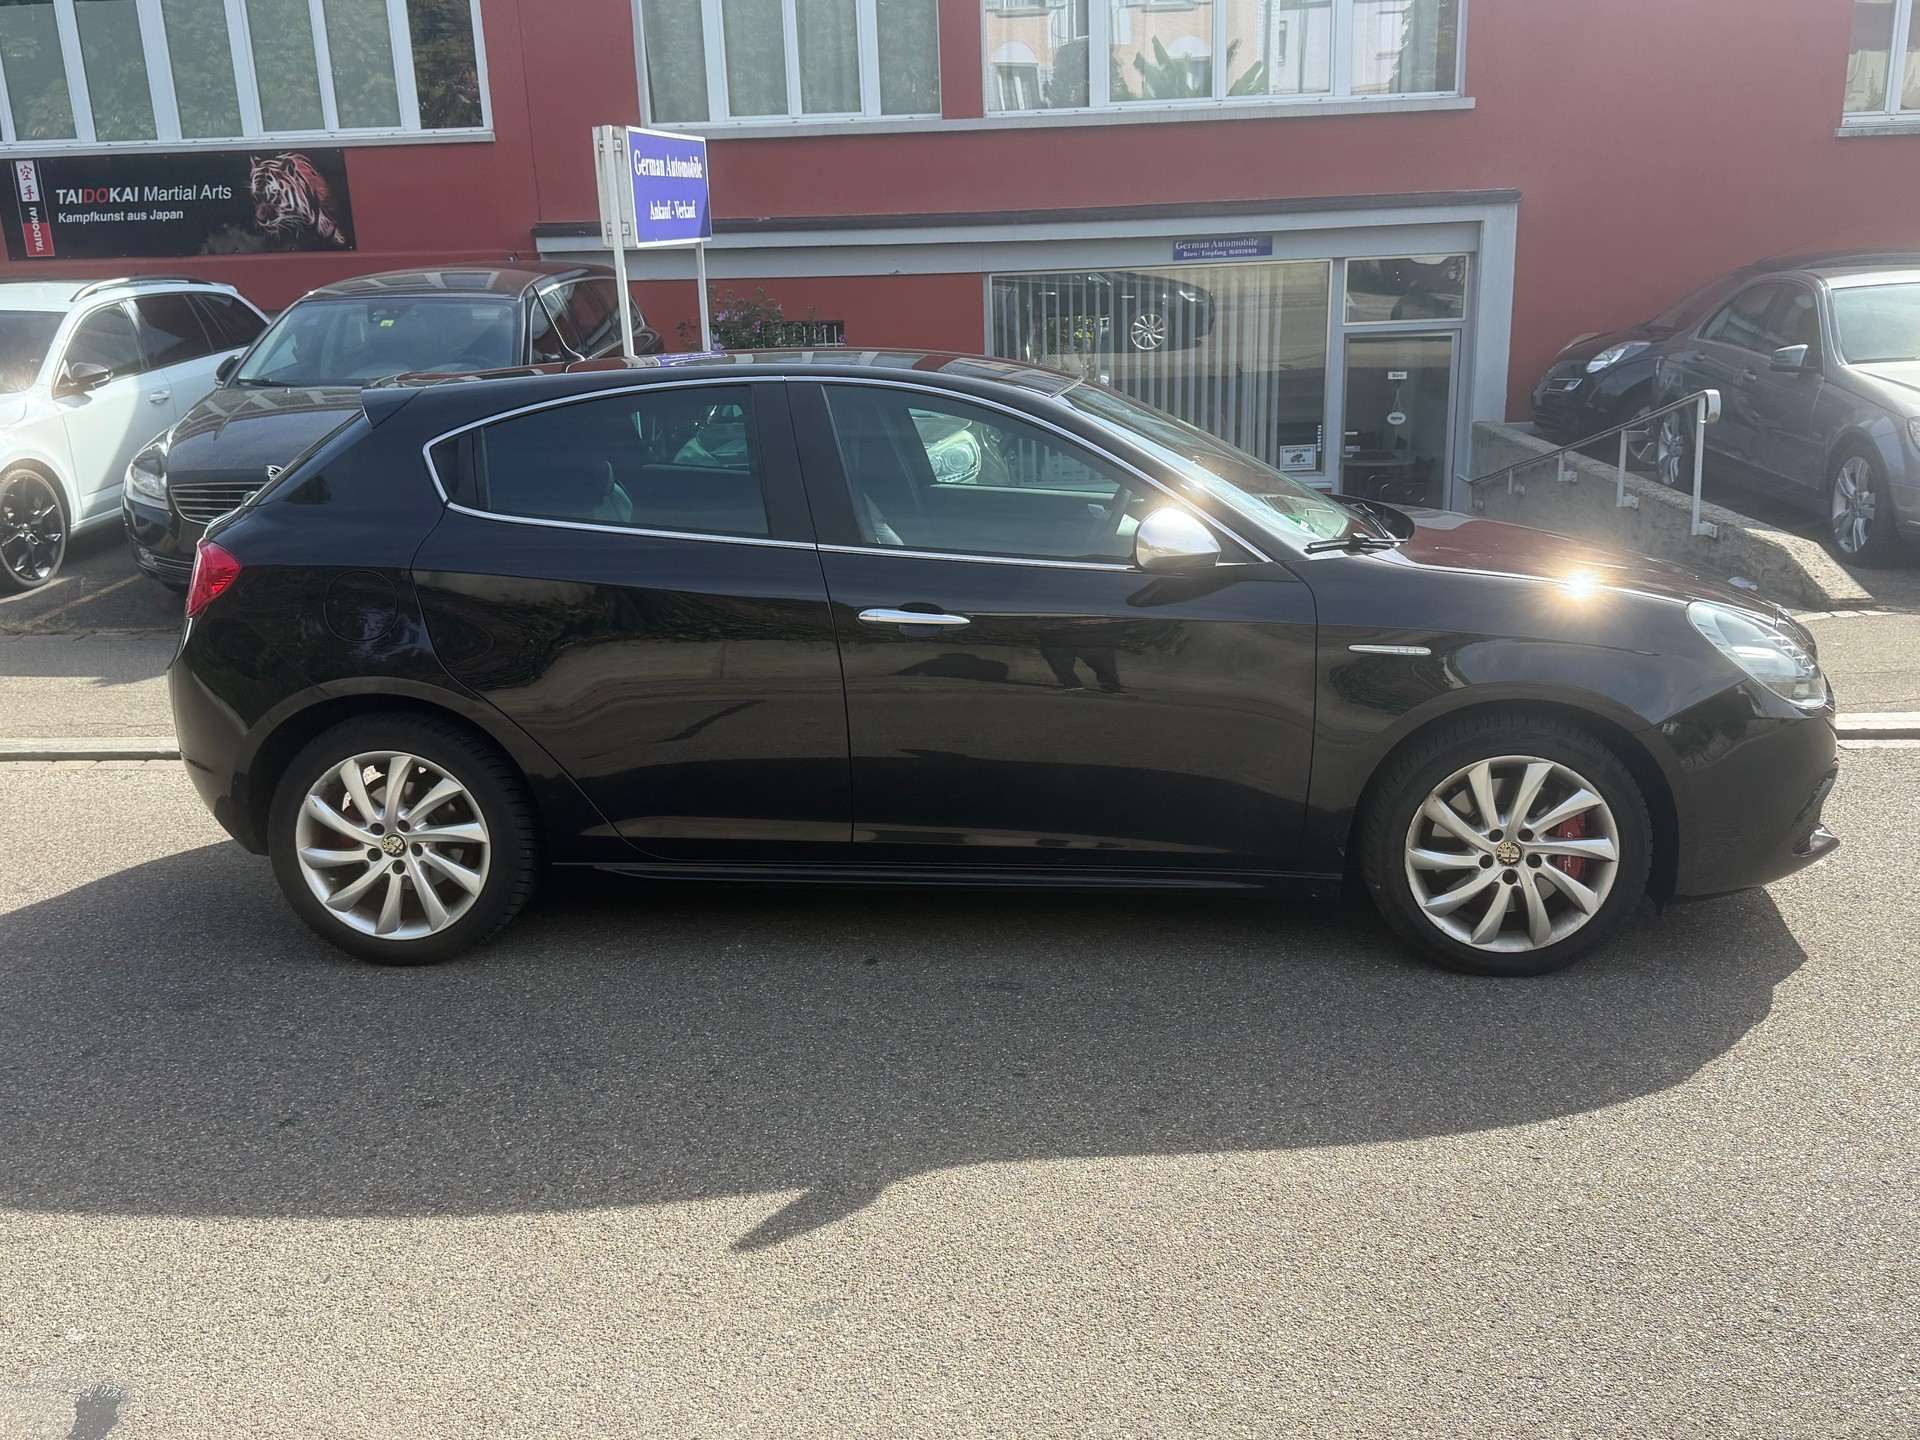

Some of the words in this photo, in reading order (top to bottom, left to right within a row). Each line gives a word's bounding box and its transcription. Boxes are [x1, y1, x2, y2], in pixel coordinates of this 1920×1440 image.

[634, 149, 665, 177] German
[666, 153, 703, 179] Automobile
[20, 165, 35, 201] 空手
[56, 186, 139, 205] TAIDOKAI
[144, 185, 196, 202] Martial
[200, 184, 232, 200] Arts
[58, 211, 125, 225] Kampfkunst
[127, 211, 147, 222] aus
[150, 209, 184, 223] Japan
[650, 199, 672, 220] Ankauf
[674, 199, 696, 219] Verkauf
[29, 207, 44, 252] TAIDOKAI
[1175, 241, 1209, 250] German
[1211, 238, 1258, 248] Automobile
